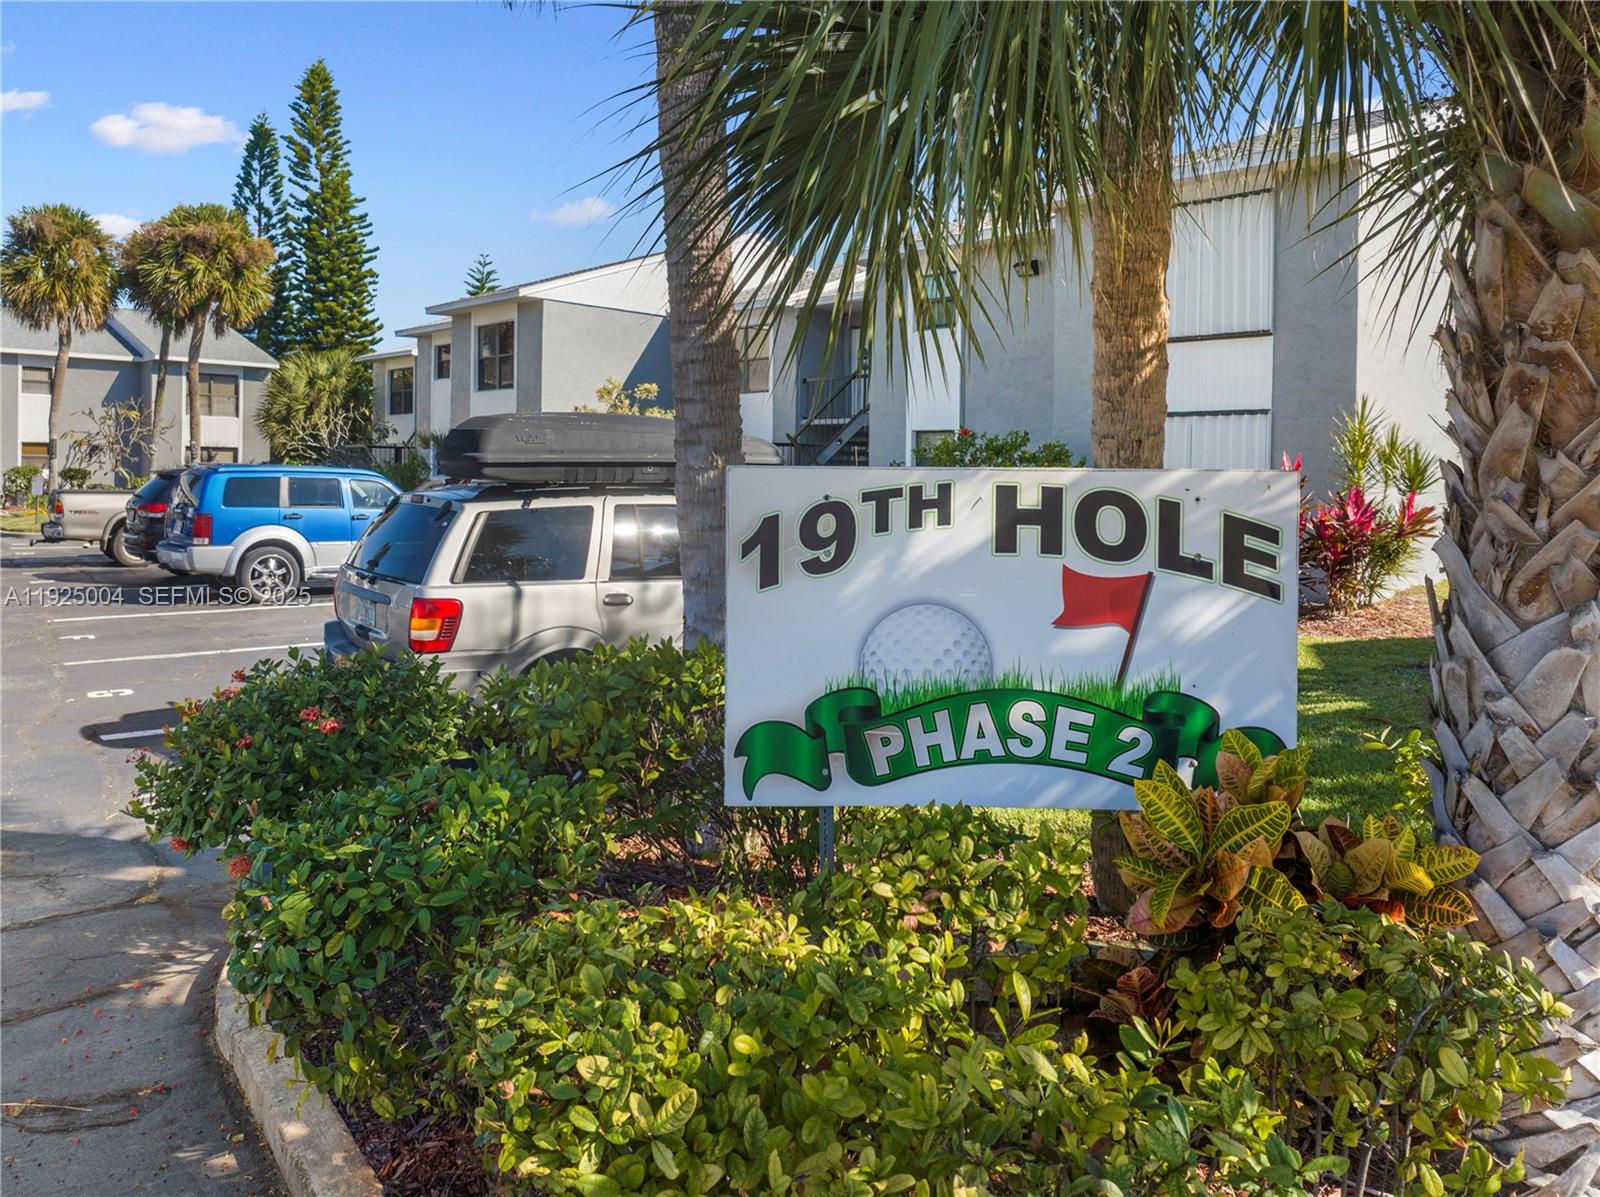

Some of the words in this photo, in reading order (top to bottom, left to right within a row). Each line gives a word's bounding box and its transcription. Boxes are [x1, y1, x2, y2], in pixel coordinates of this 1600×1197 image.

[737, 481, 954, 593] 19TH
[991, 481, 1284, 603] HOLE
[864, 700, 1096, 777] PHASE
[1106, 725, 1154, 779] 2
